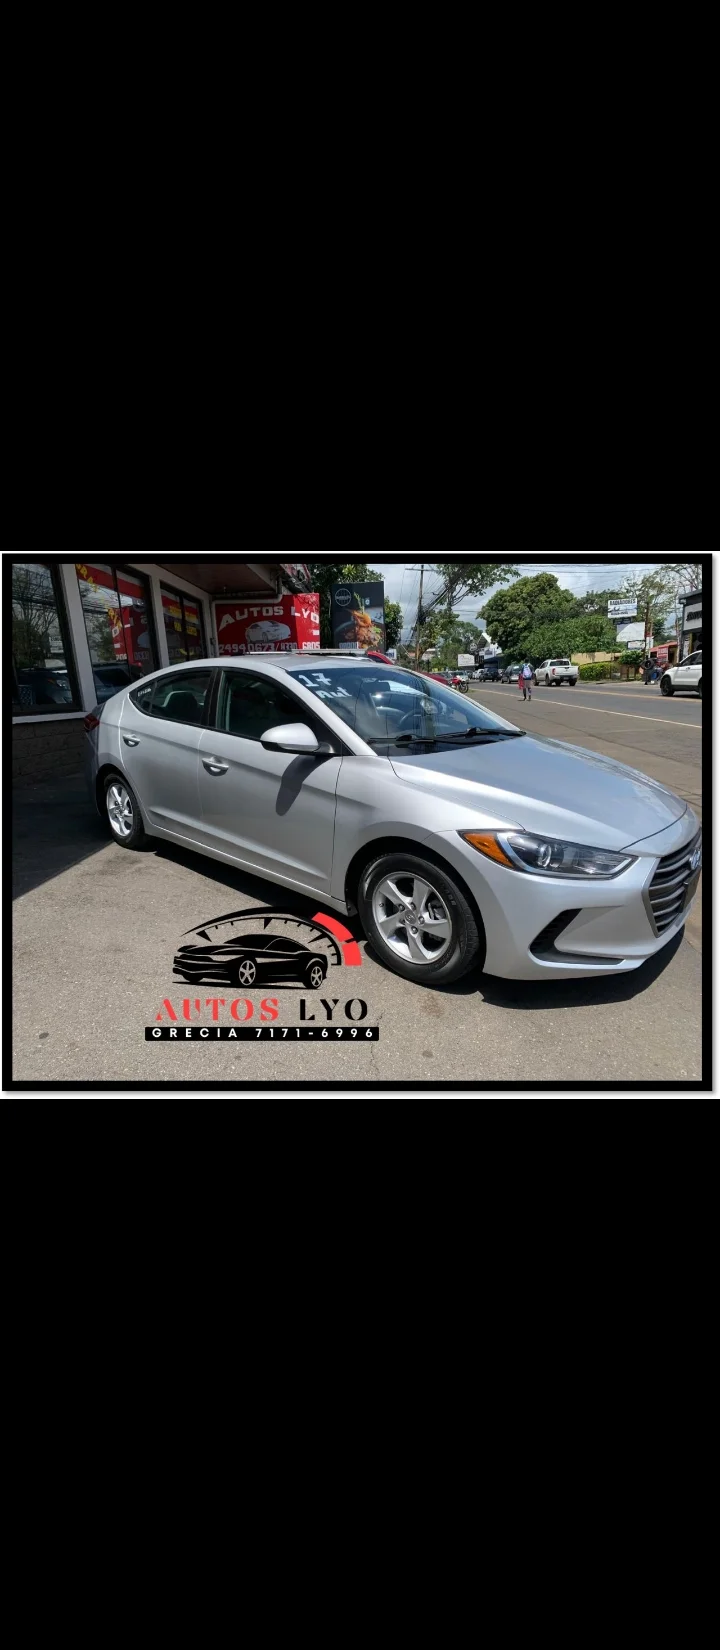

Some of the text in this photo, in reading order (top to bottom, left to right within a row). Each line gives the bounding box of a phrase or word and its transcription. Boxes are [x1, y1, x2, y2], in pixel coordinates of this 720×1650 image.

[218, 606, 284, 631] AUTOS
[290, 606, 320, 624] LYO
[298, 672, 332, 687] 17
[315, 686, 353, 699] Aut
